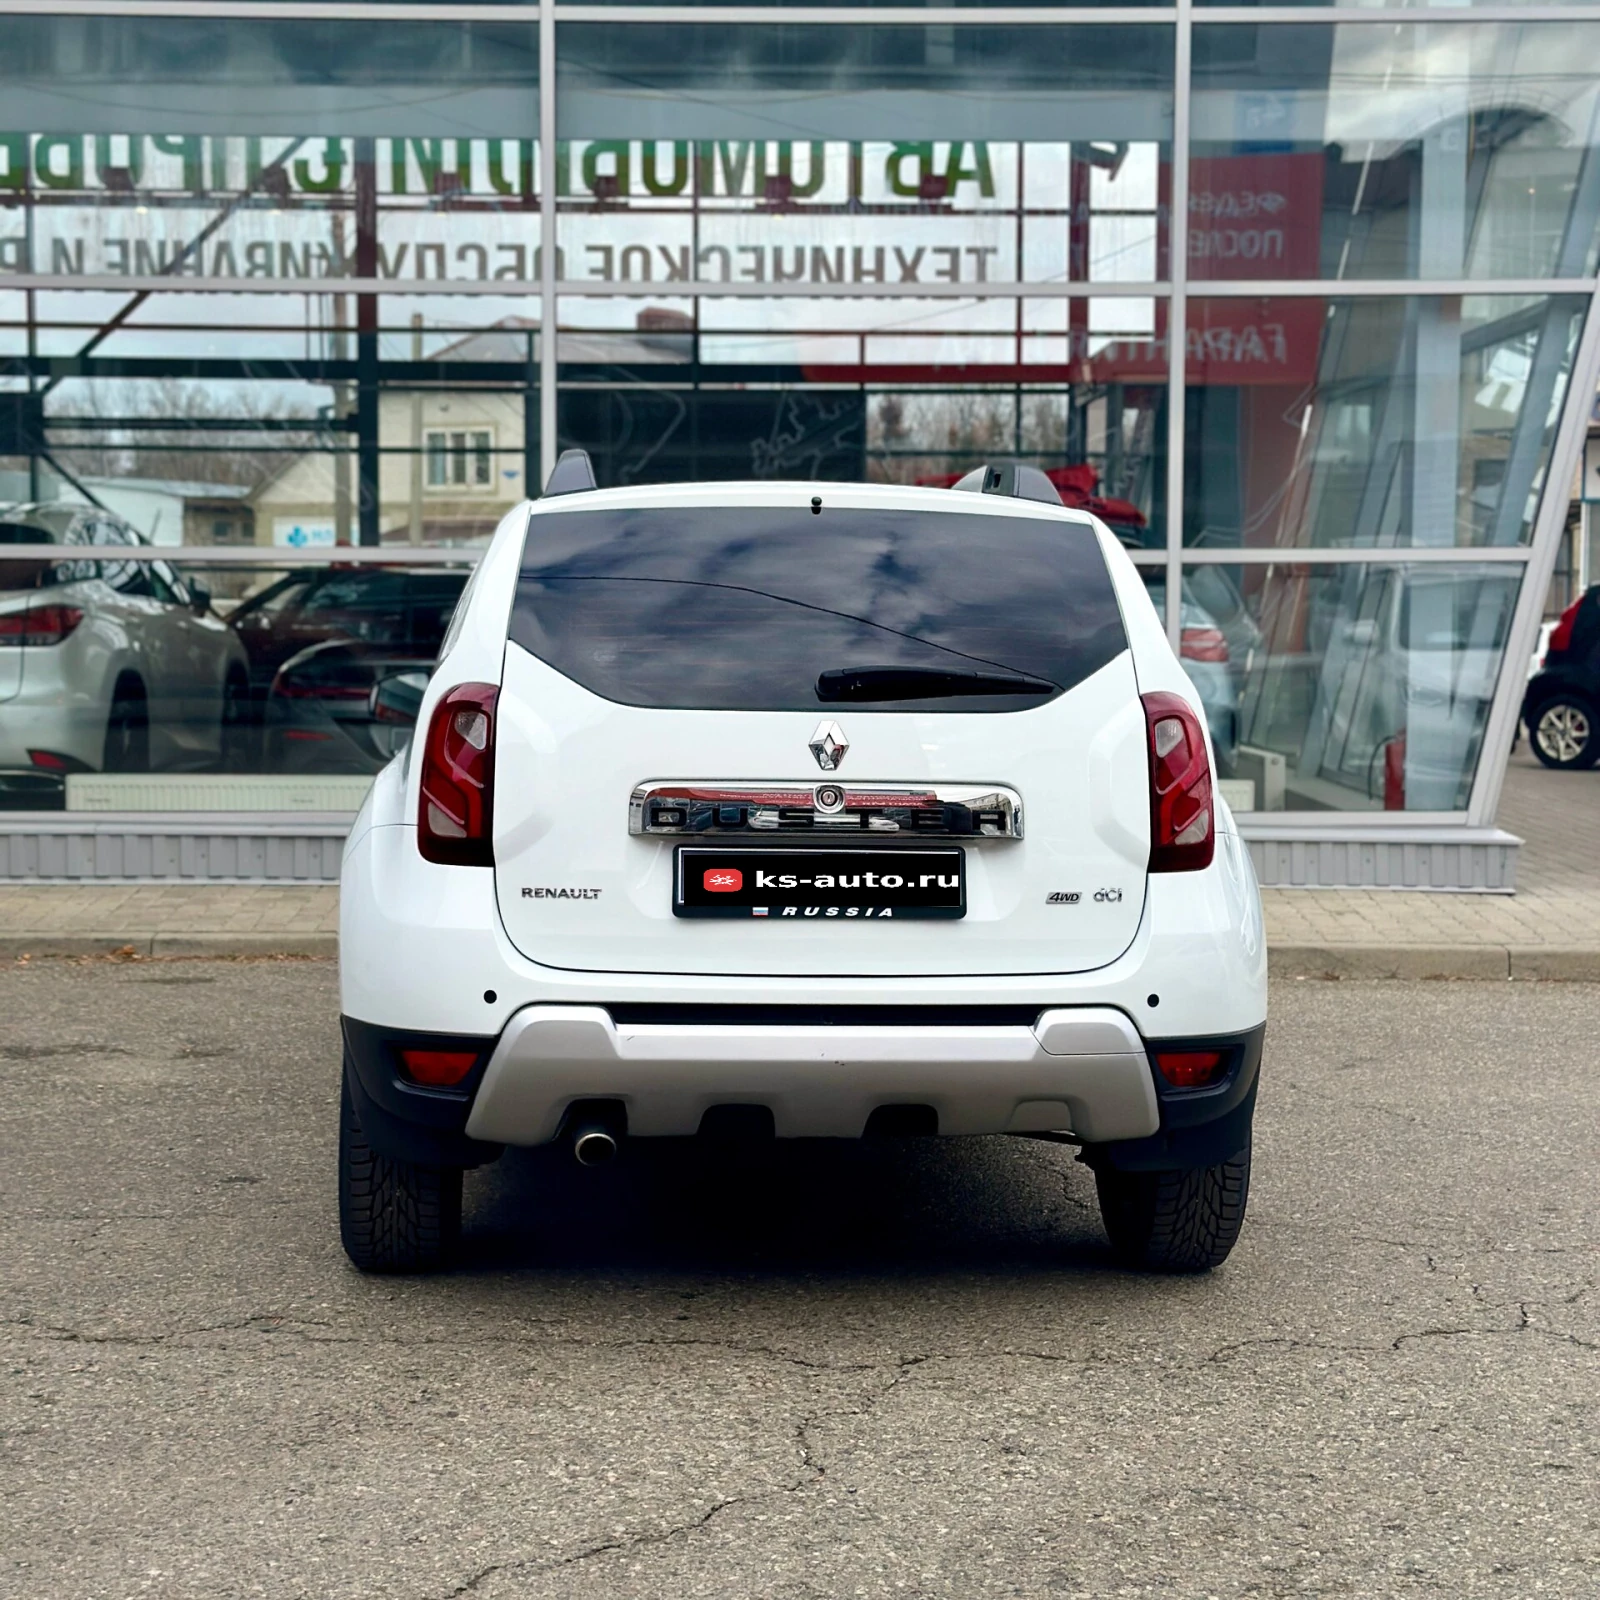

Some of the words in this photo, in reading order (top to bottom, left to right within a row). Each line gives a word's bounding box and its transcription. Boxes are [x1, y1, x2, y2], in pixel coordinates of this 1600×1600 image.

[650, 806, 1007, 832] DUSTER
[521, 887, 602, 900] RENAULT
[1048, 891, 1080, 902] 4WD
[782, 906, 894, 918] RUSSIA
